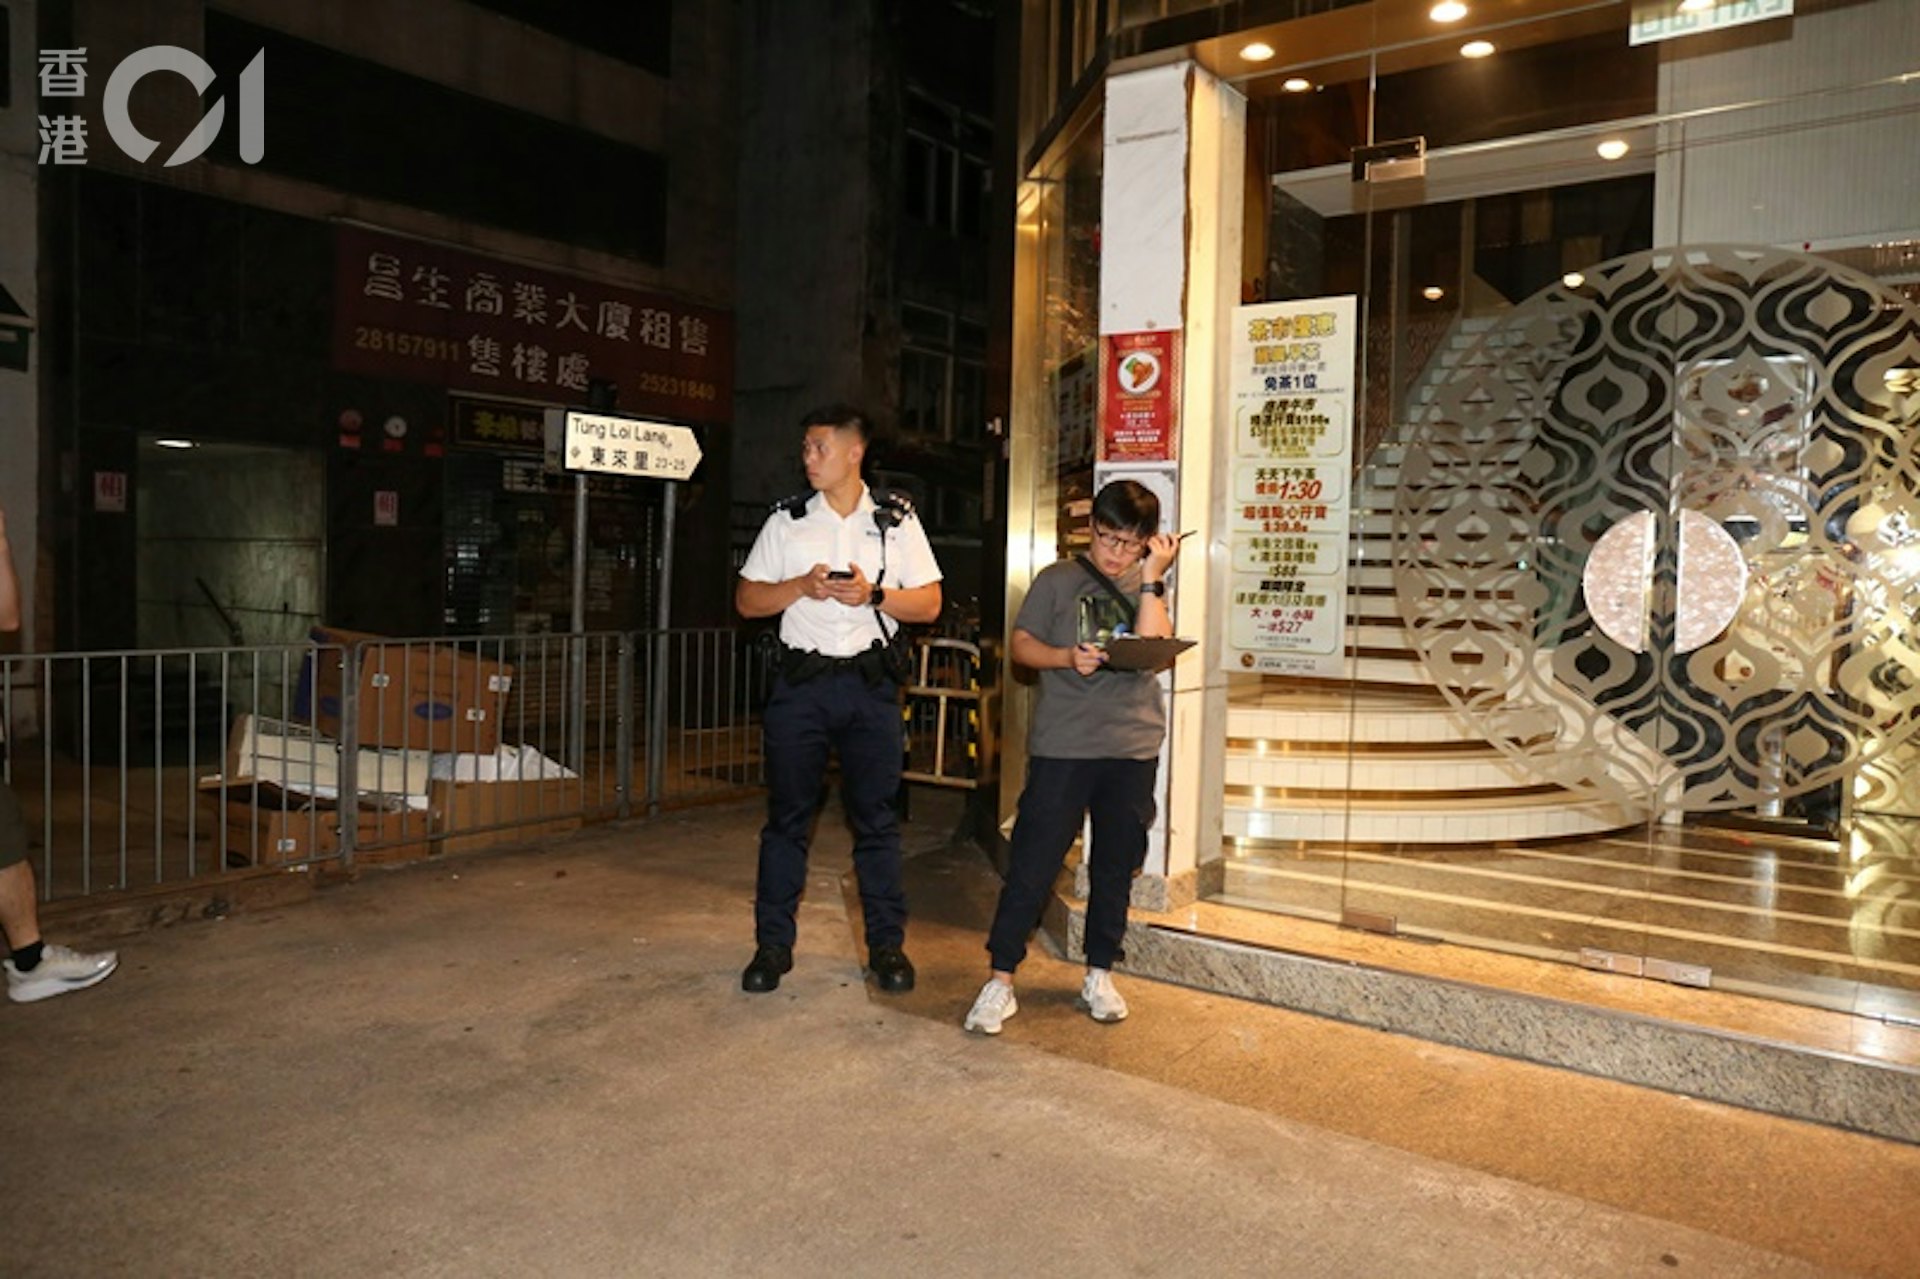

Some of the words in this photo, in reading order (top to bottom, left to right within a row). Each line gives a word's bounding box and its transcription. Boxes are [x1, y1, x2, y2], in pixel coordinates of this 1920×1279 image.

[354, 326, 461, 362] 28157911
[466, 333, 592, 392] 售樓處
[572, 417, 606, 439] Tung
[609, 422, 632, 441] Loi
